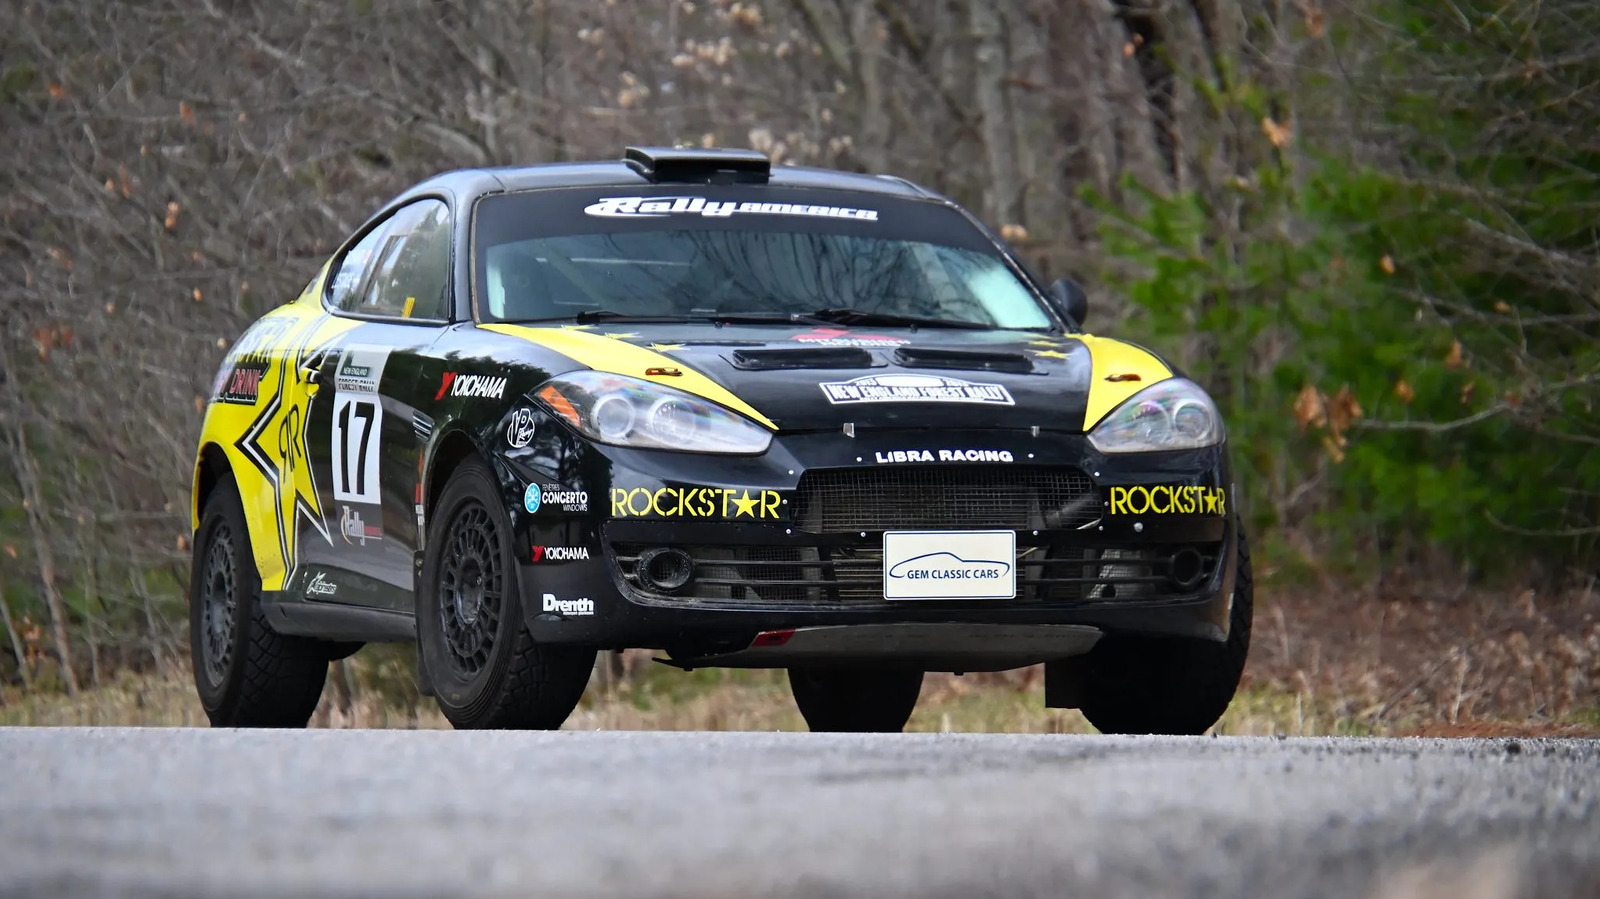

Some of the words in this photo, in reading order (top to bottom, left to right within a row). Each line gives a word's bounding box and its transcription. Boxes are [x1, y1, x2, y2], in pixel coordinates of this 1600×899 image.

[584, 196, 737, 217] Rally
[229, 368, 261, 394] DRINK
[450, 374, 507, 399] YOKOHAMA
[826, 384, 861, 400] NEW
[859, 386, 920, 398] ENGLAND
[917, 386, 965, 398] FOREST
[963, 385, 1005, 400] RALLY
[338, 400, 375, 495] 17
[875, 450, 935, 464] LIBRA
[938, 449, 1014, 463] RACING
[541, 490, 588, 504] CONCERTO
[562, 503, 588, 512] WINDOWS
[543, 546, 590, 560] YOKOHAMA
[906, 569, 930, 580] GEM
[931, 569, 972, 580] CLASSIC
[972, 569, 1000, 580] CARS
[542, 593, 595, 612] Drenth
